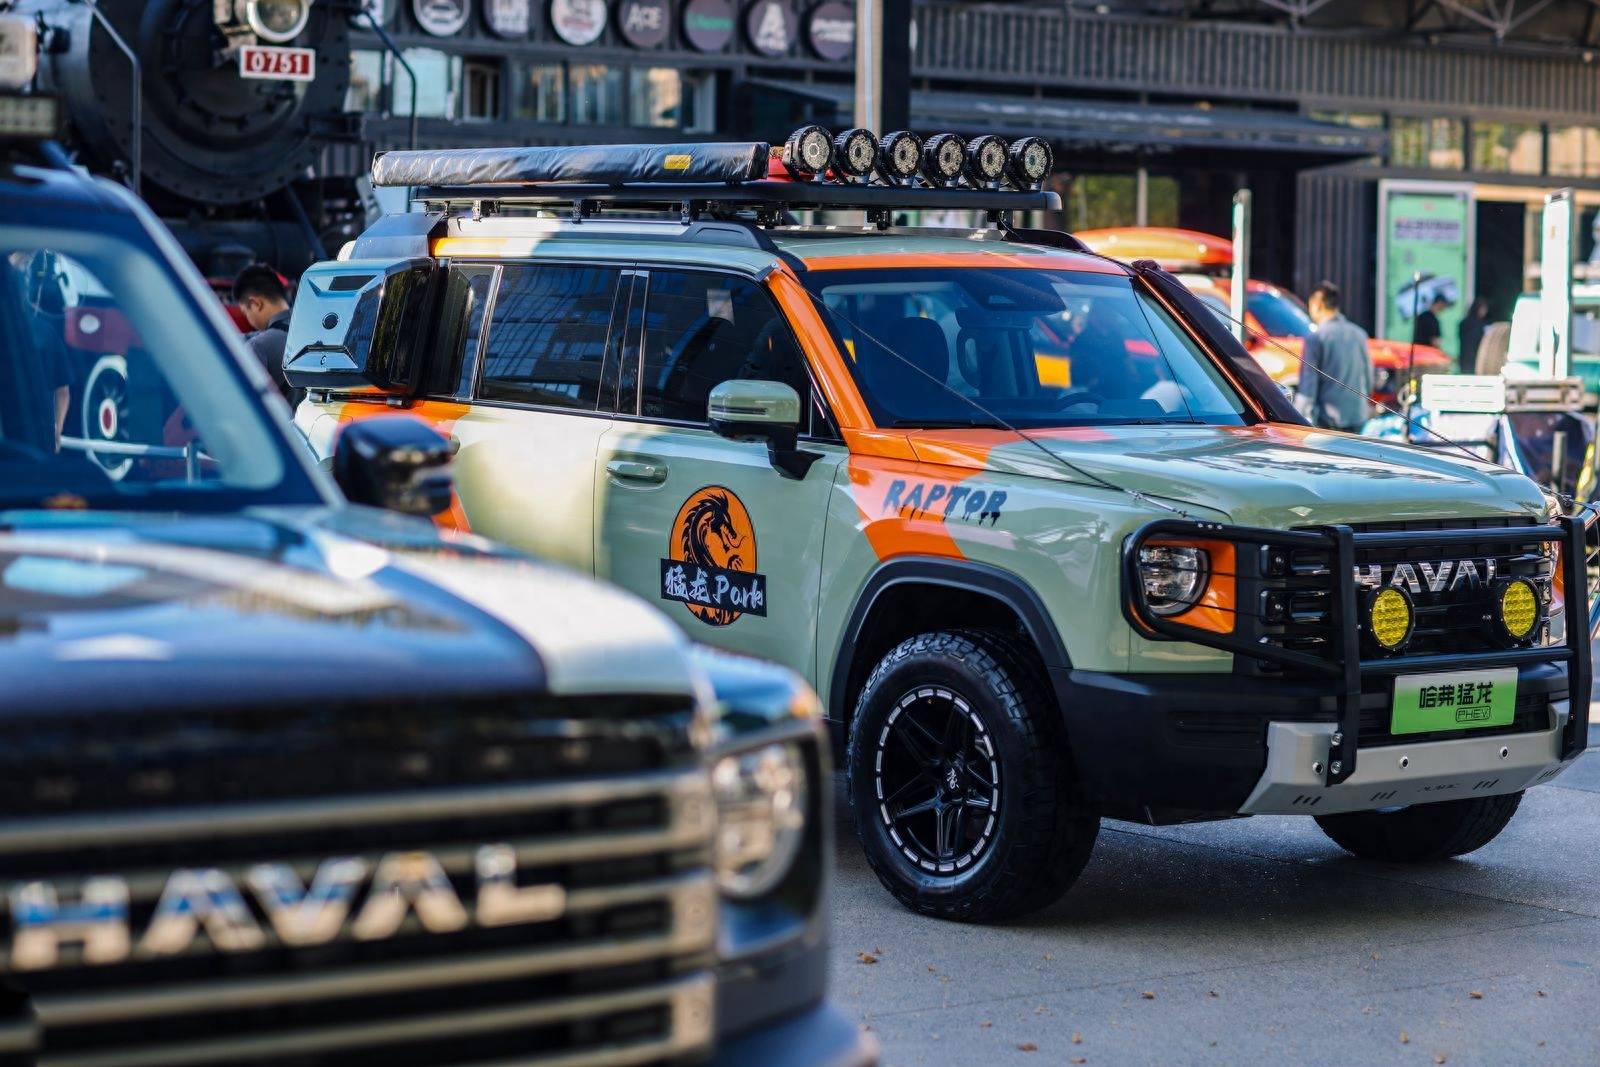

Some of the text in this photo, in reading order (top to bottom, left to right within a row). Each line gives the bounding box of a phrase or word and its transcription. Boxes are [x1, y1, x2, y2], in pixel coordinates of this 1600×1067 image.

[250, 51, 303, 75] 0751
[882, 480, 1008, 526] RAPTOR
[1418, 681, 1494, 709] 哈弗猛龙
[8, 842, 567, 970] HAVAL
